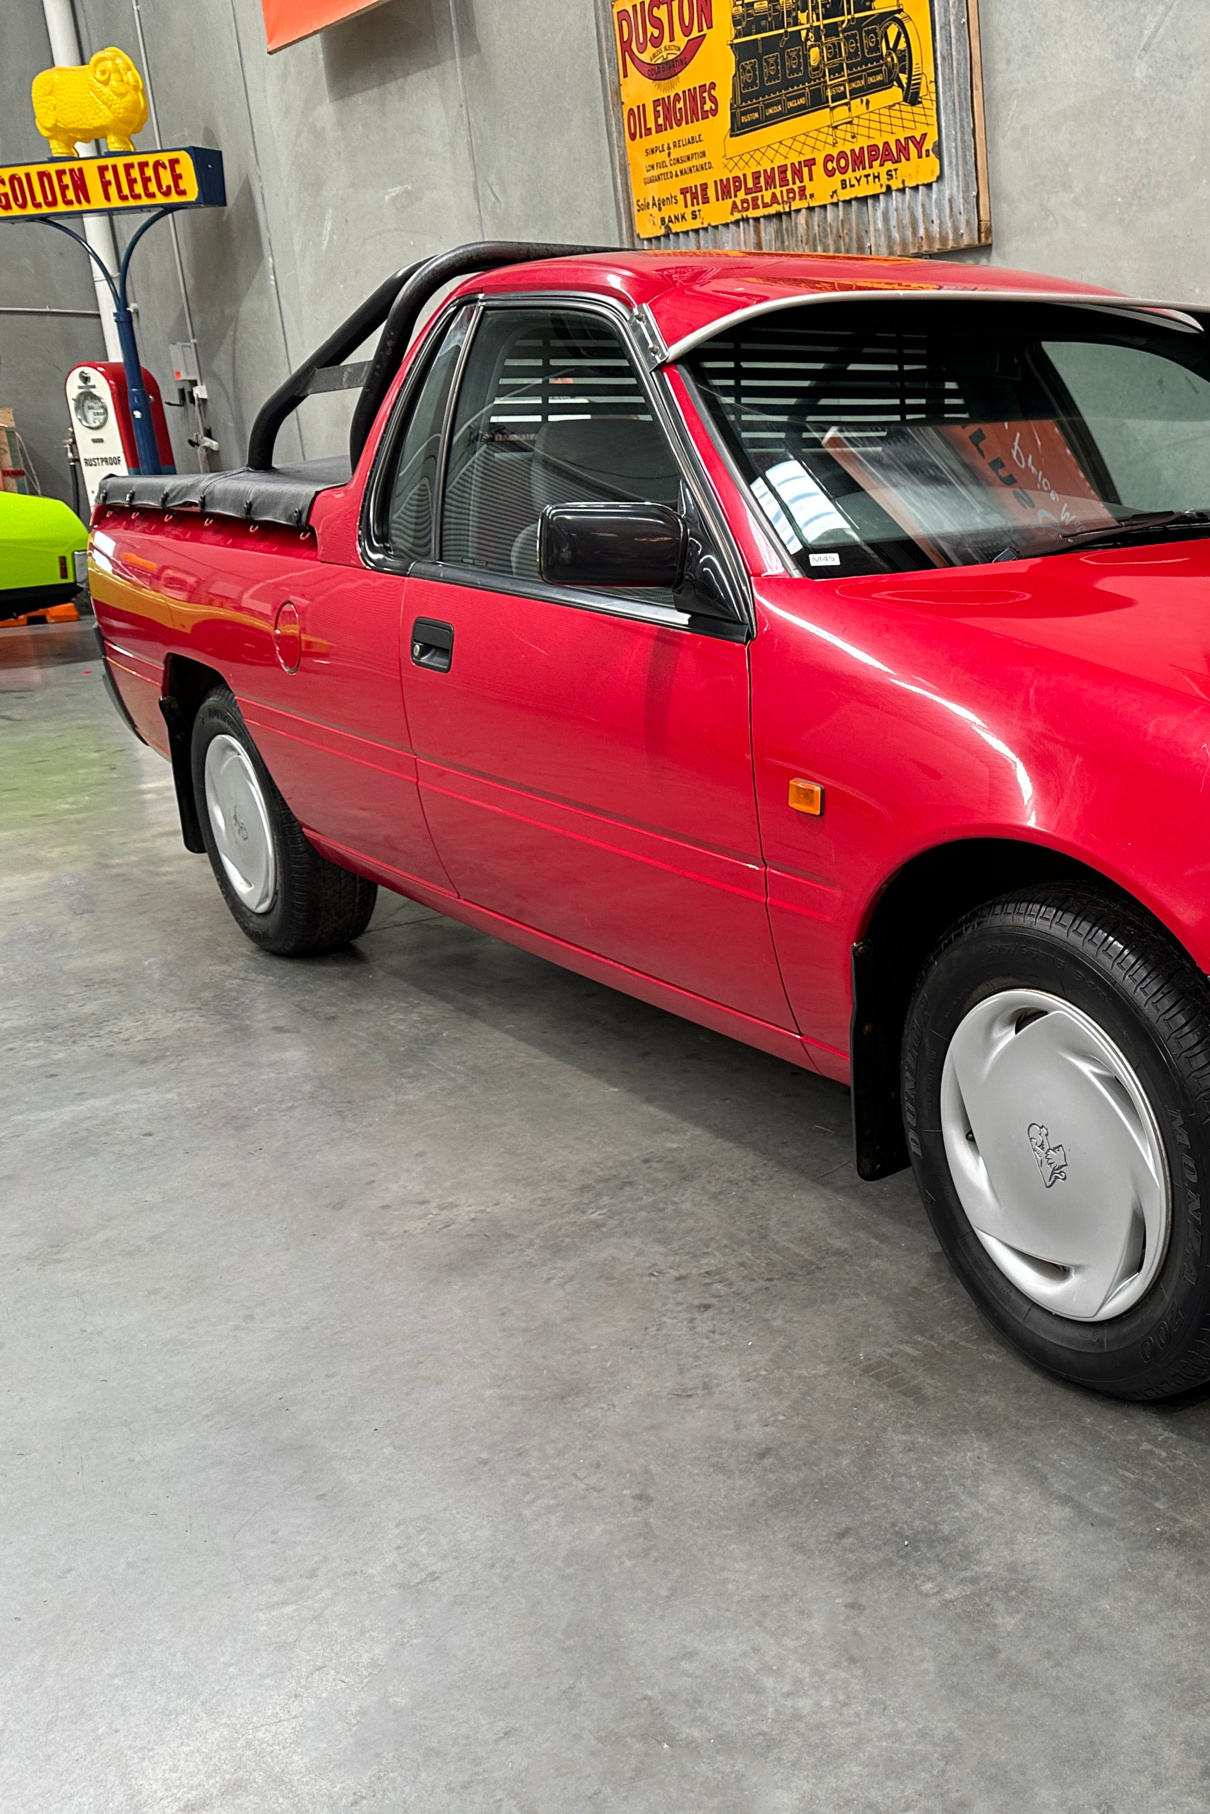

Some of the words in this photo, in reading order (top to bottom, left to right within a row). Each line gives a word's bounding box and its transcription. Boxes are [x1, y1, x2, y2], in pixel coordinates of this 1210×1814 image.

[617, 0, 714, 79] RUSTON
[627, 103, 652, 142] OIL
[652, 81, 719, 134] ENGINES
[741, 112, 759, 123] RUSTON
[765, 105, 782, 116] LINCOLN
[786, 97, 806, 109] ENGLAND
[645, 143, 665, 157] SIMPLE
[645, 163, 655, 173] LOW
[656, 160, 668, 170] FUEL
[669, 150, 707, 166] CONSUMPTION
[0, 166, 91, 211] GOLDEN
[97, 157, 188, 202] FLEECE
[636, 199, 650, 213] Sole
[651, 193, 679, 212] Agents
[679, 182, 710, 209] THE
[713, 157, 817, 202] IMPLEMENT
[822, 132, 931, 178] COMPANY.
[643, 171, 674, 186] GUARANTEED
[840, 171, 881, 190] BLYTH
[660, 212, 687, 226] BANK
[83, 455, 122, 467] RUSTPROOF
[904, 991, 930, 1160] DUNLOP
[1164, 1104, 1203, 1286] MONZA
